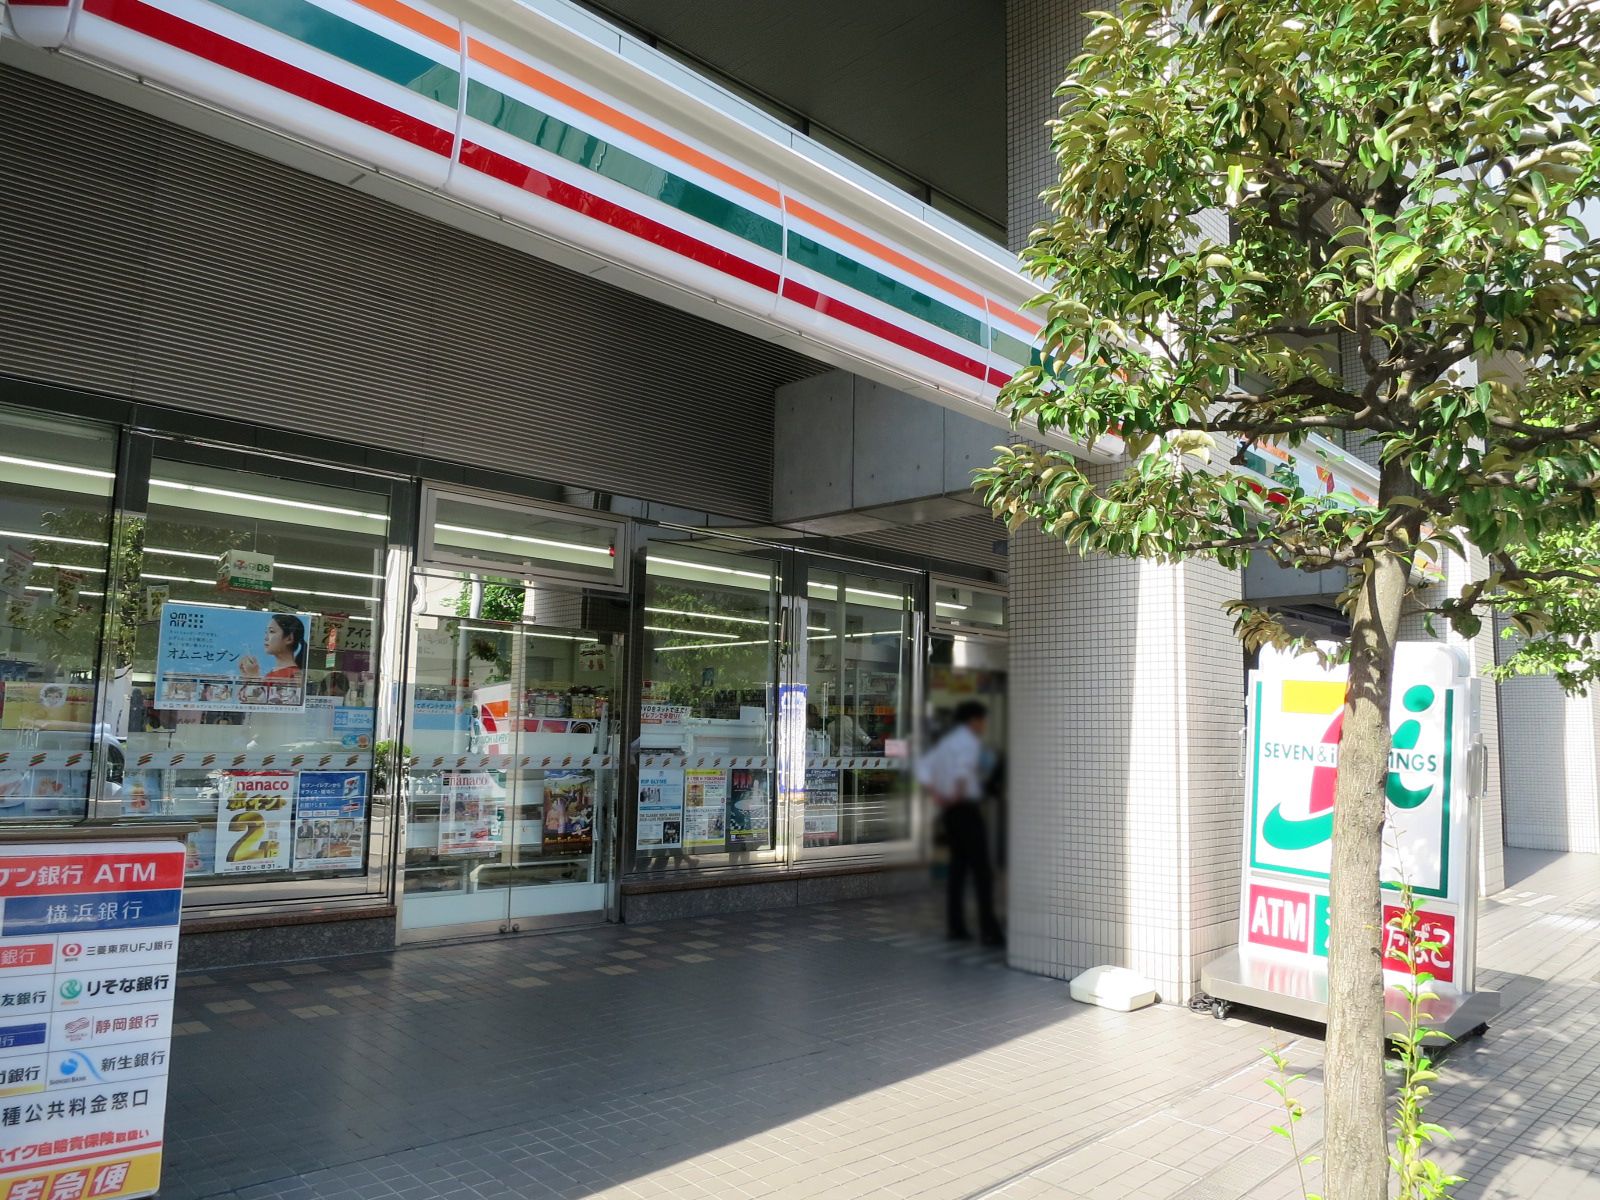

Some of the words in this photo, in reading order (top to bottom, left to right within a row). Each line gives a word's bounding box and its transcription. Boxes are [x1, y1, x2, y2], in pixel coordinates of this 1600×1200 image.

[167, 648, 240, 662] オムニセブン
[1264, 742, 1314, 761] SEVEN
[1317, 750, 1327, 763] &
[1388, 752, 1437, 773] INGS
[236, 780, 289, 792] nanaco
[450, 777, 488, 786] nanaco
[226, 811, 266, 862] 2
[94, 862, 157, 884] ATM
[47, 900, 144, 924] 横浜銀行
[1251, 895, 1307, 943] ATM
[86, 940, 173, 956] 三菱東京UFJ銀行
[1385, 922, 1451, 968] たばこ
[1, 948, 36, 965] 銀行
[87, 975, 169, 996] りそな銀行
[95, 1014, 159, 1034] 静岡銀行
[0, 1035, 15, 1047] 行
[101, 1050, 165, 1072] 新生銀行
[2, 1089, 149, 1127] 種公共料金窓口
[8, 1163, 130, 1200] 宅急便
